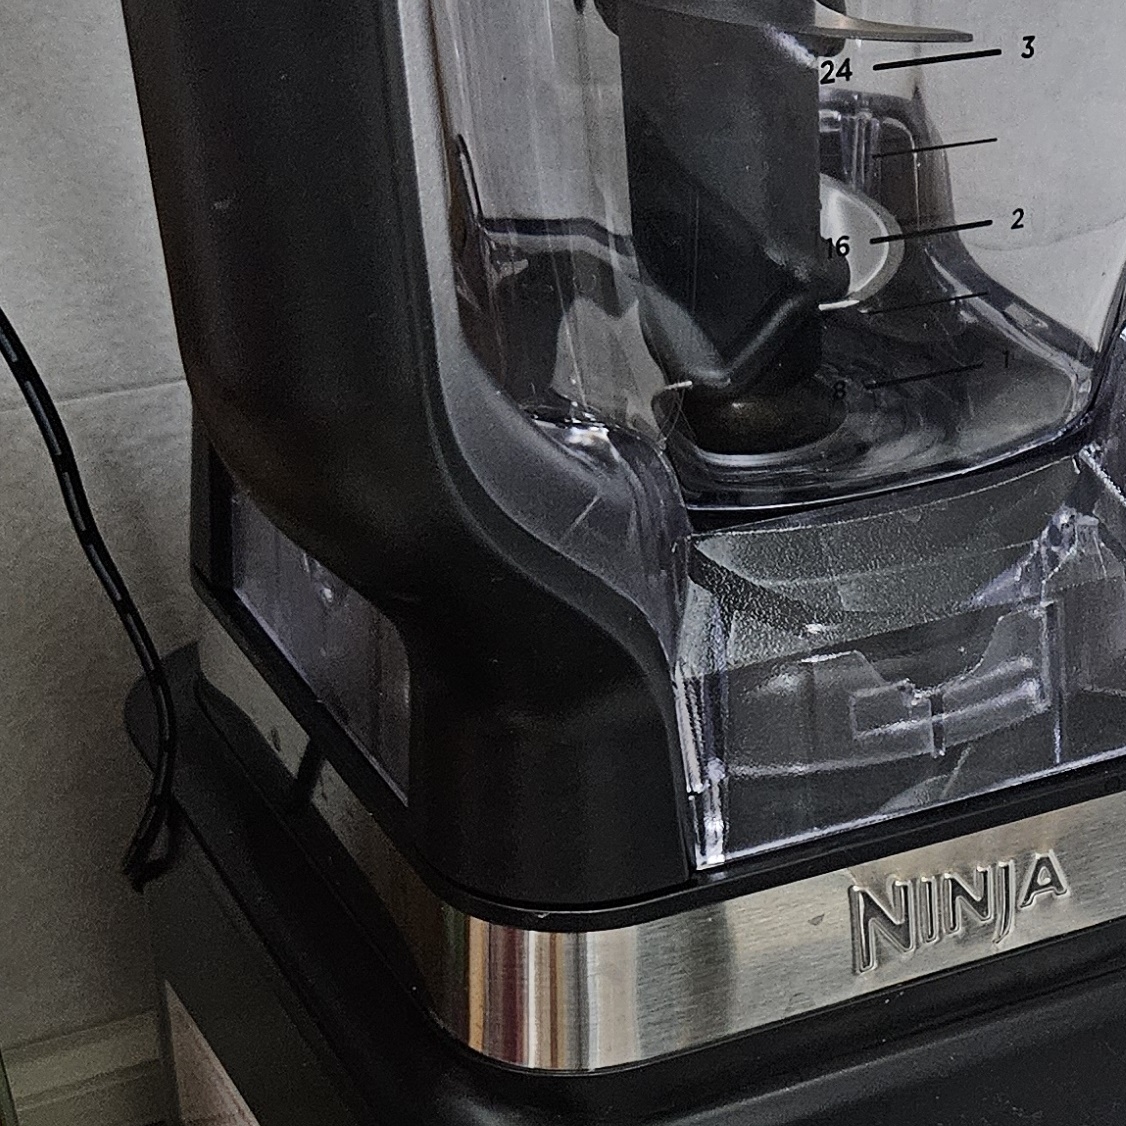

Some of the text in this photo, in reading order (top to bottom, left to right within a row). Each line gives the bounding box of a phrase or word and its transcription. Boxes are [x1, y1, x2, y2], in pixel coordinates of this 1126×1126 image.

[1021, 36, 1036, 59] 3
[820, 59, 853, 85] 24
[1010, 208, 1025, 230] 2
[826, 236, 850, 258] 16
[849, 849, 1069, 974] NINJA
